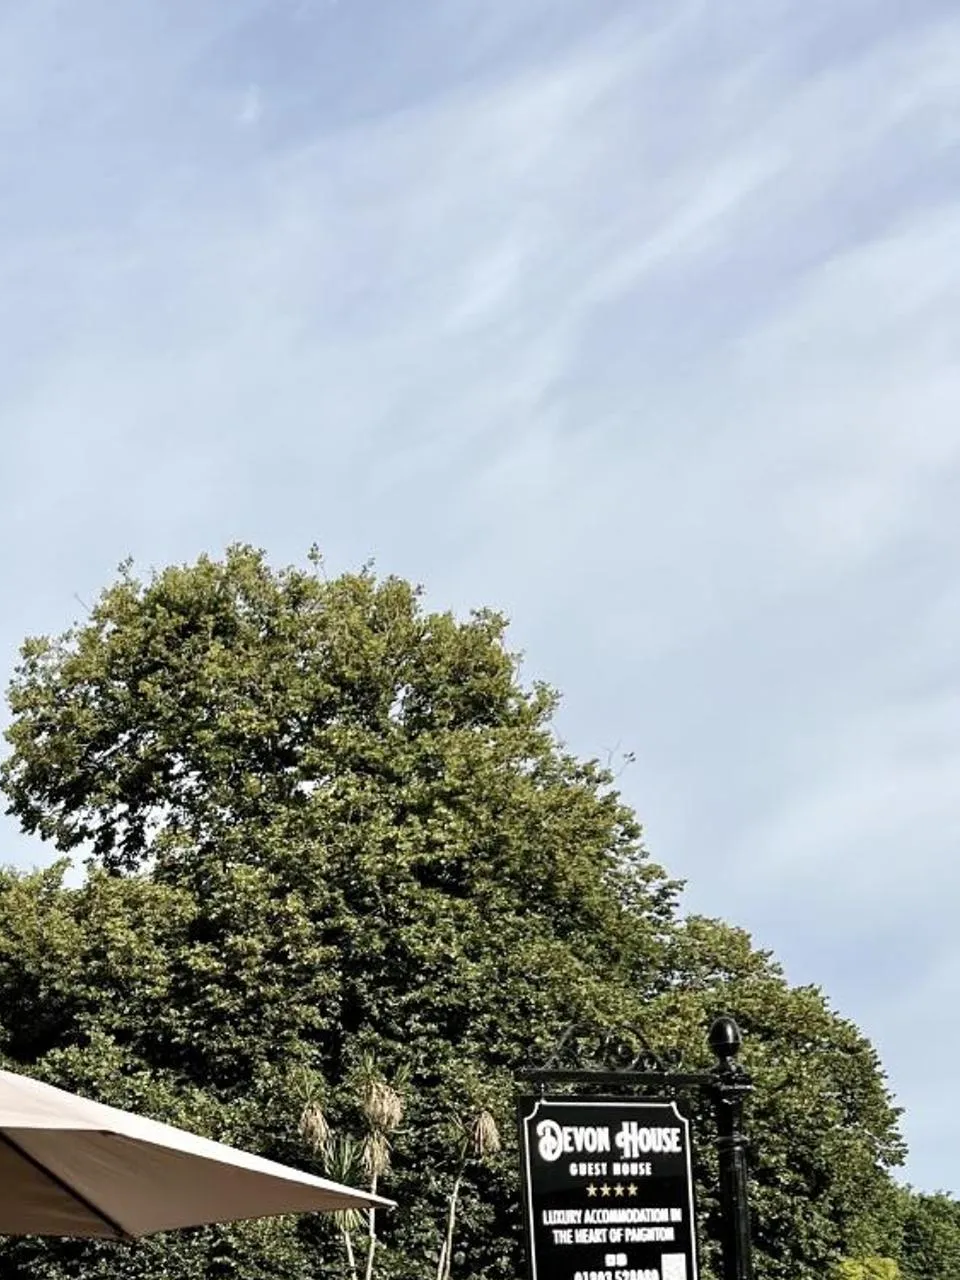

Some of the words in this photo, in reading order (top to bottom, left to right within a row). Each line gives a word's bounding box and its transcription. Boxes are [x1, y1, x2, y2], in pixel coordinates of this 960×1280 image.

[615, 1121, 682, 1159] HOUSE
[569, 1162, 608, 1176] GUEST
[613, 1162, 652, 1176] HOUSE
[542, 1209, 582, 1225] LUXURY
[584, 1208, 669, 1224] ACCOMMODATION
[670, 1207, 682, 1222] IN
[552, 1229, 573, 1244] THE
[574, 1228, 608, 1243] HEART
[609, 1227, 623, 1243] OF
[624, 1227, 675, 1242] PAIGNTON
